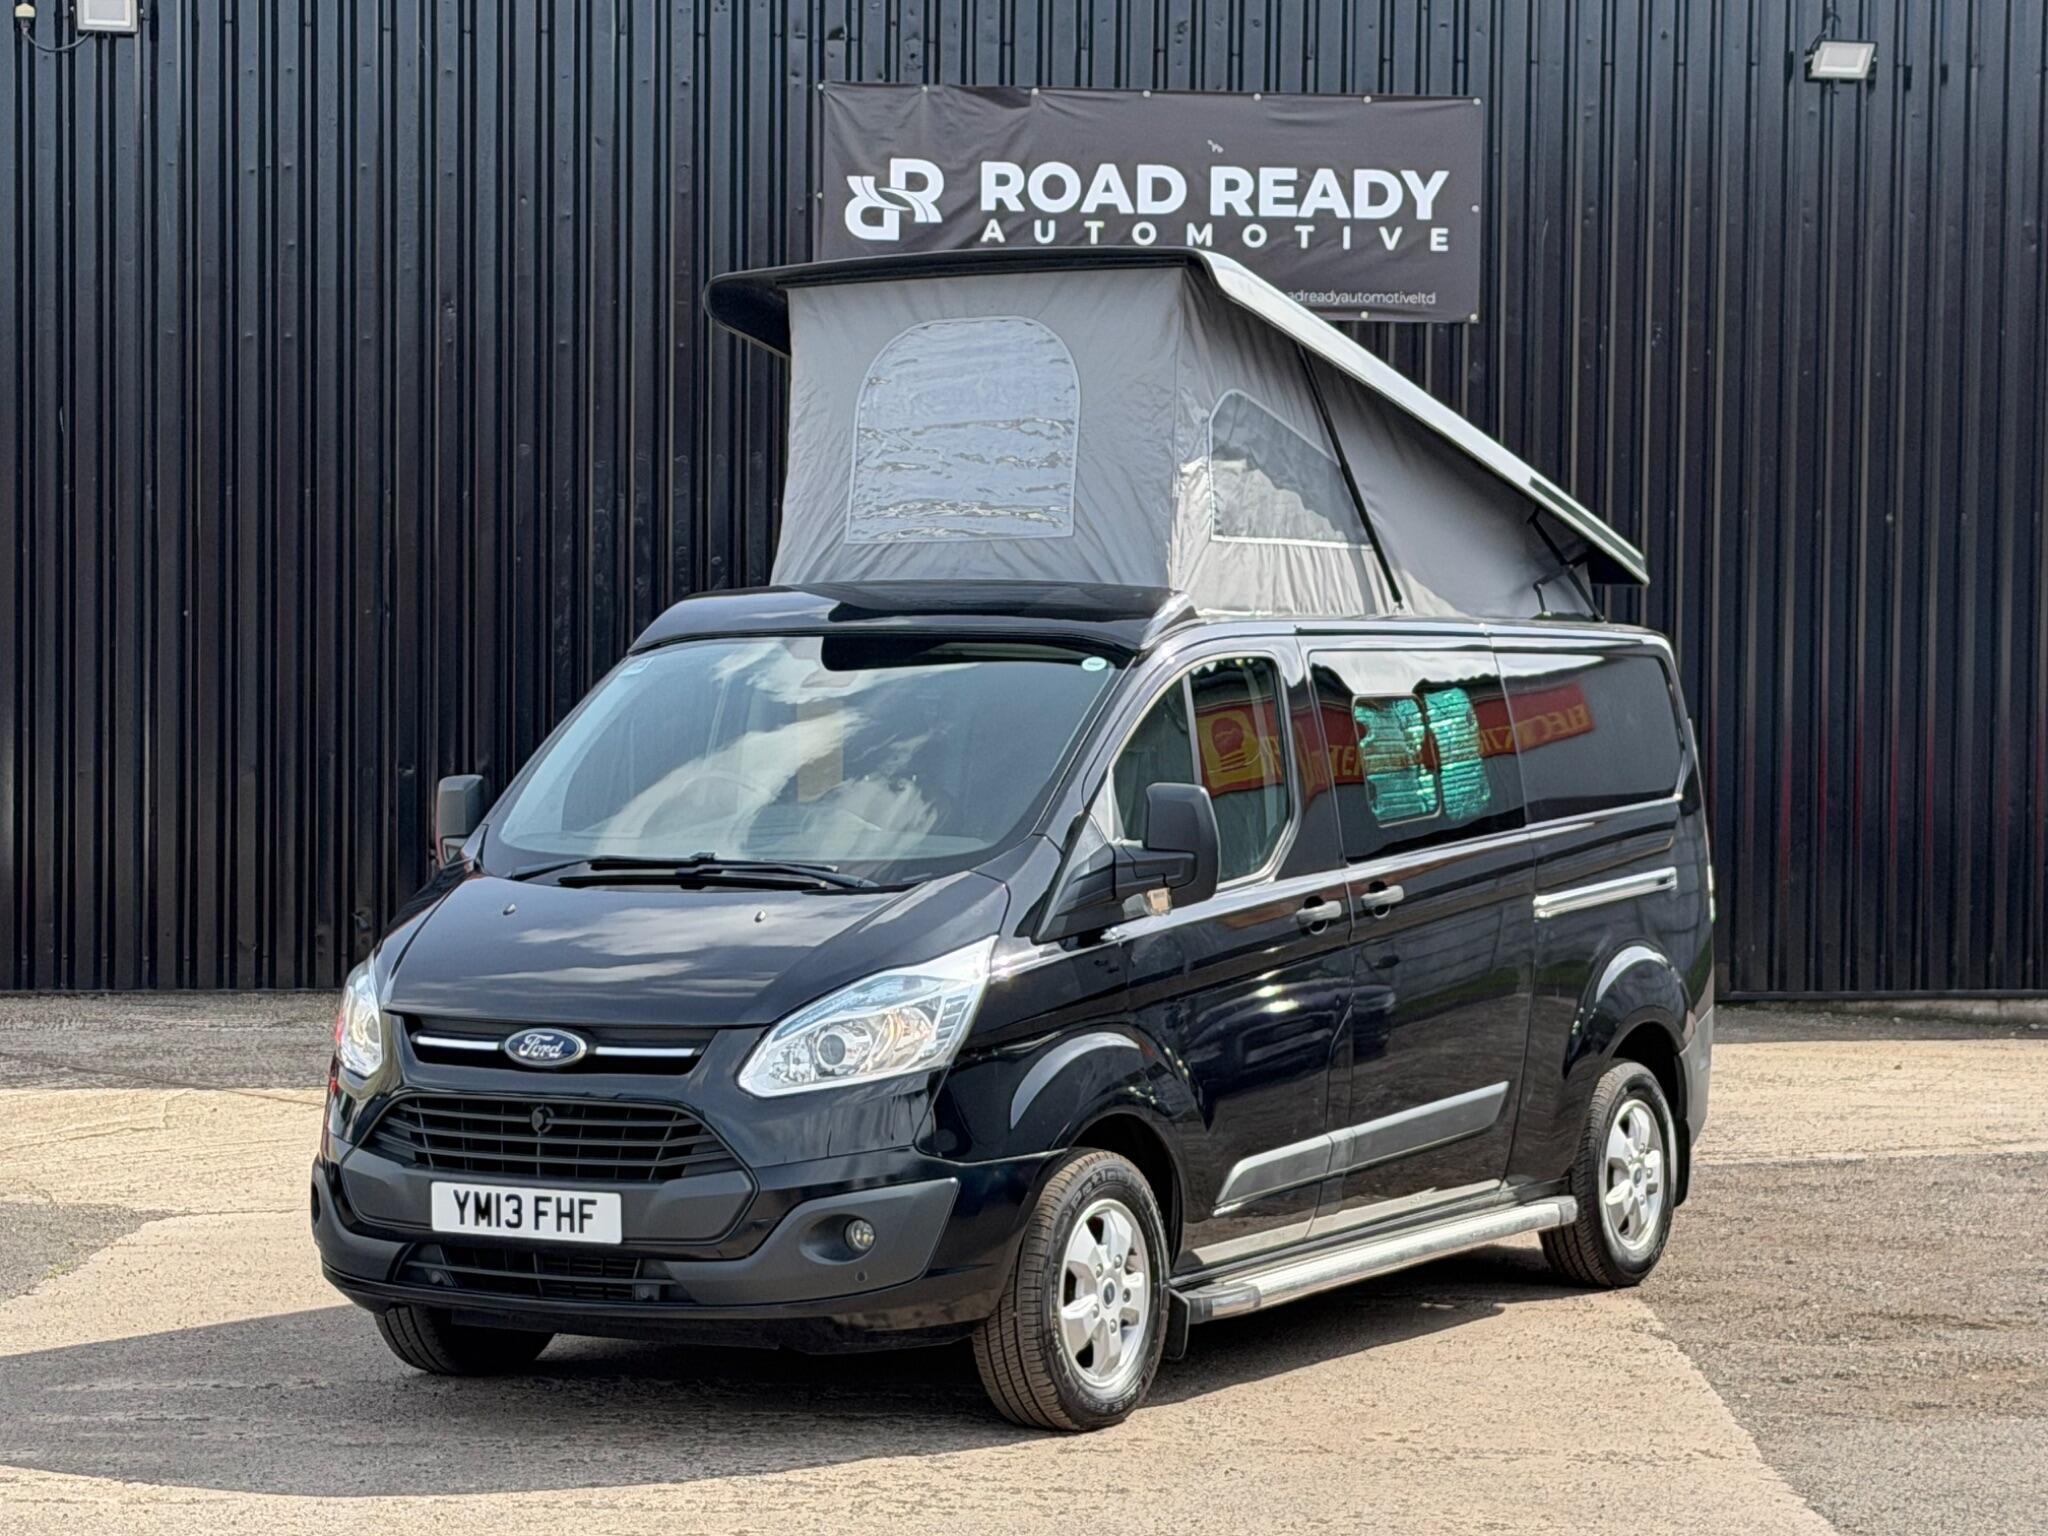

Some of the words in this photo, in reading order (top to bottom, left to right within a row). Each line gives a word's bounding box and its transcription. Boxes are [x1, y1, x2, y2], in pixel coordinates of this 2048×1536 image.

[980, 161, 1187, 215] ROAD
[1210, 166, 1449, 220] READY
[980, 218, 1449, 251] AUTOMOTIVE
[519, 1033, 563, 1058] Ford
[453, 1190, 523, 1229] YM13
[534, 1196, 597, 1234] FHF
